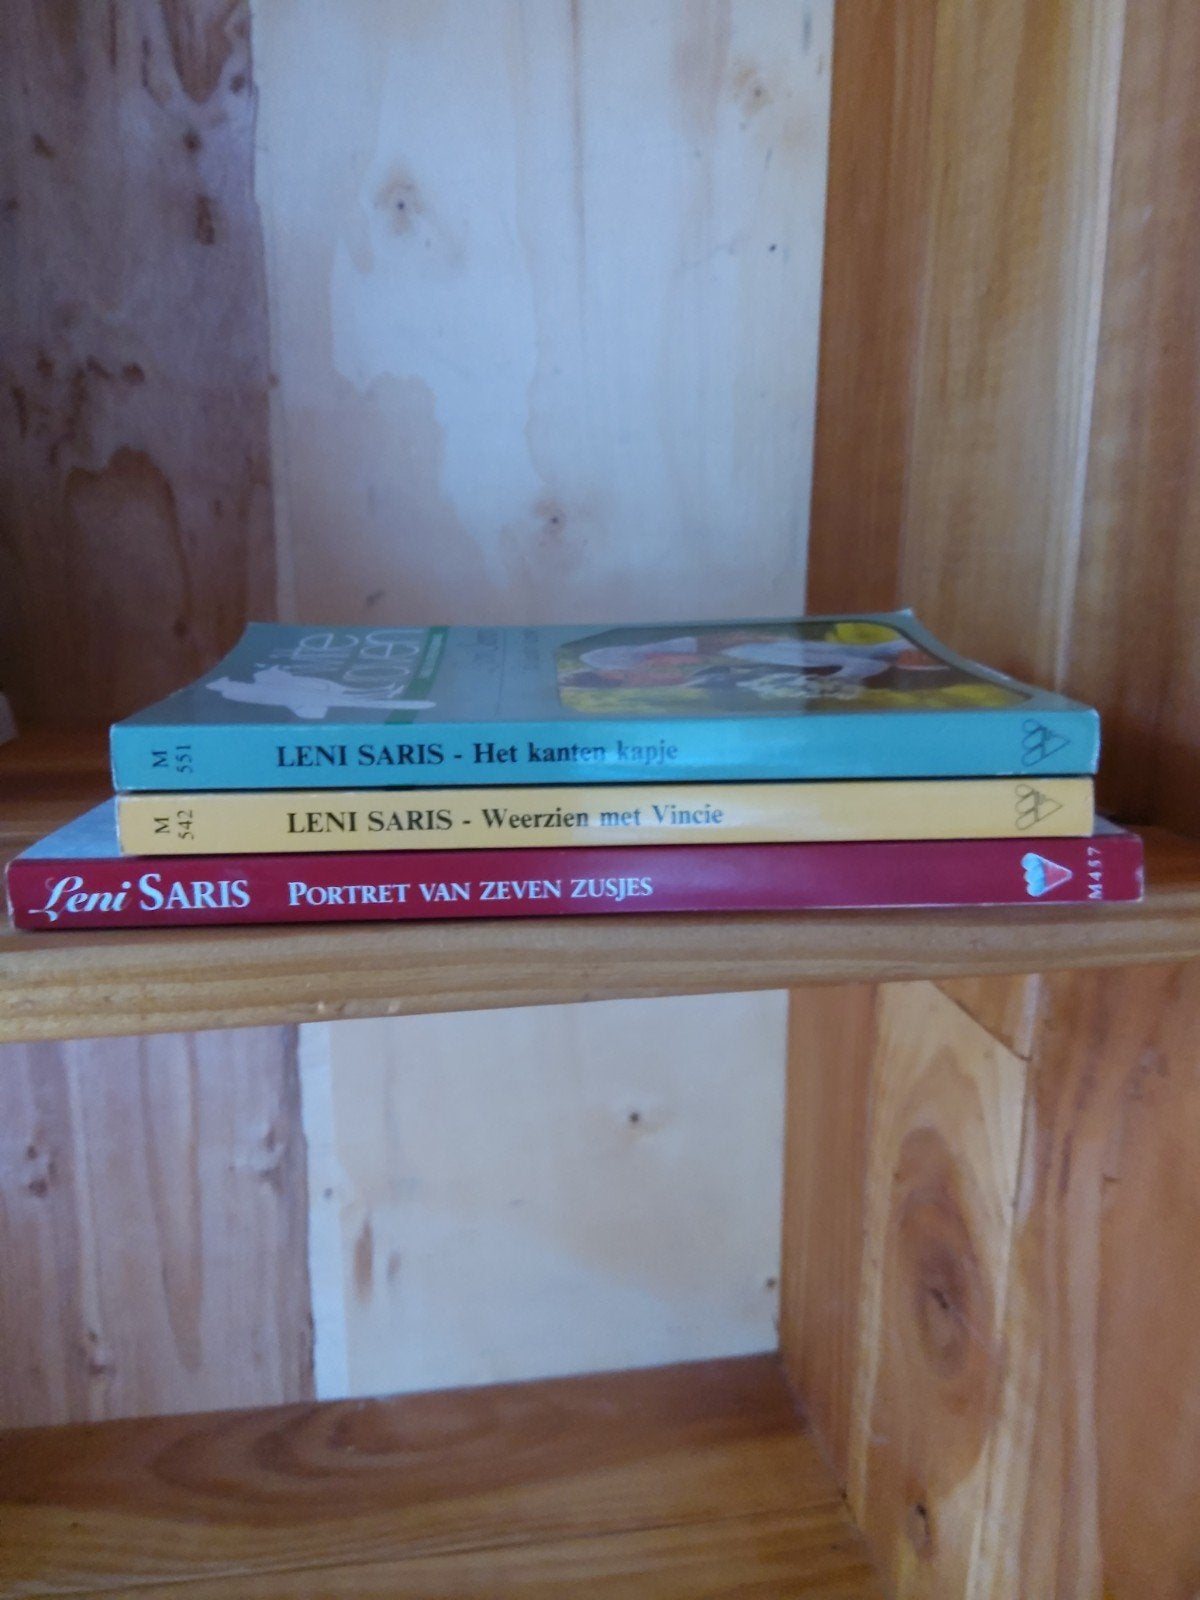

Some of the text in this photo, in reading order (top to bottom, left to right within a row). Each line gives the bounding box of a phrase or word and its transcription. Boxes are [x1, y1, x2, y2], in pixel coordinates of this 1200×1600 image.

[152, 750, 169, 768] M
[175, 744, 193, 774] 551
[276, 744, 348, 768] LENI
[358, 742, 445, 767] SARIS
[473, 742, 518, 764] Het
[527, 740, 606, 763] kanten
[616, 738, 679, 767] kapje
[153, 817, 171, 835] M
[176, 808, 195, 840] 542
[287, 811, 357, 834] LENI
[367, 809, 454, 832] SARIS
[481, 806, 590, 830] Weerzien
[599, 809, 643, 827] met
[651, 803, 725, 826] Vincie
[27, 872, 654, 922] Leni SARIS PORTRET VAN ZEVEN ZUSJES
